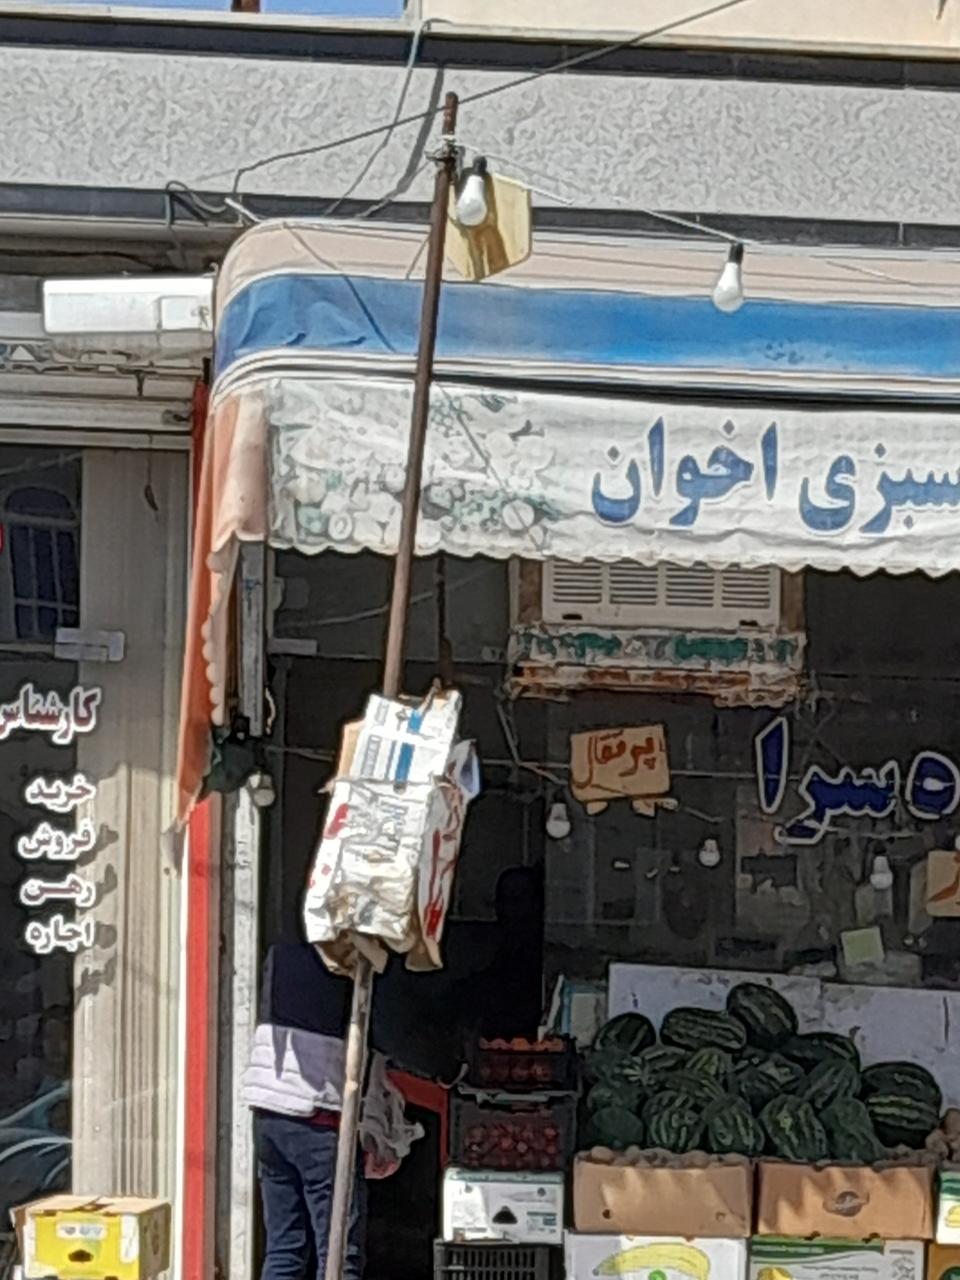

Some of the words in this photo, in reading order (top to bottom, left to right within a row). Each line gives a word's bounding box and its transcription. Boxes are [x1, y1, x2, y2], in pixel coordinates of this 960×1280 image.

[590, 415, 779, 527] اخوان
[25, 773, 97, 812] خرید
[755, 716, 900, 845] سرا
[18, 819, 96, 859] فروش
[20, 873, 96, 907] رهن
[25, 915, 95, 953] اجاره
